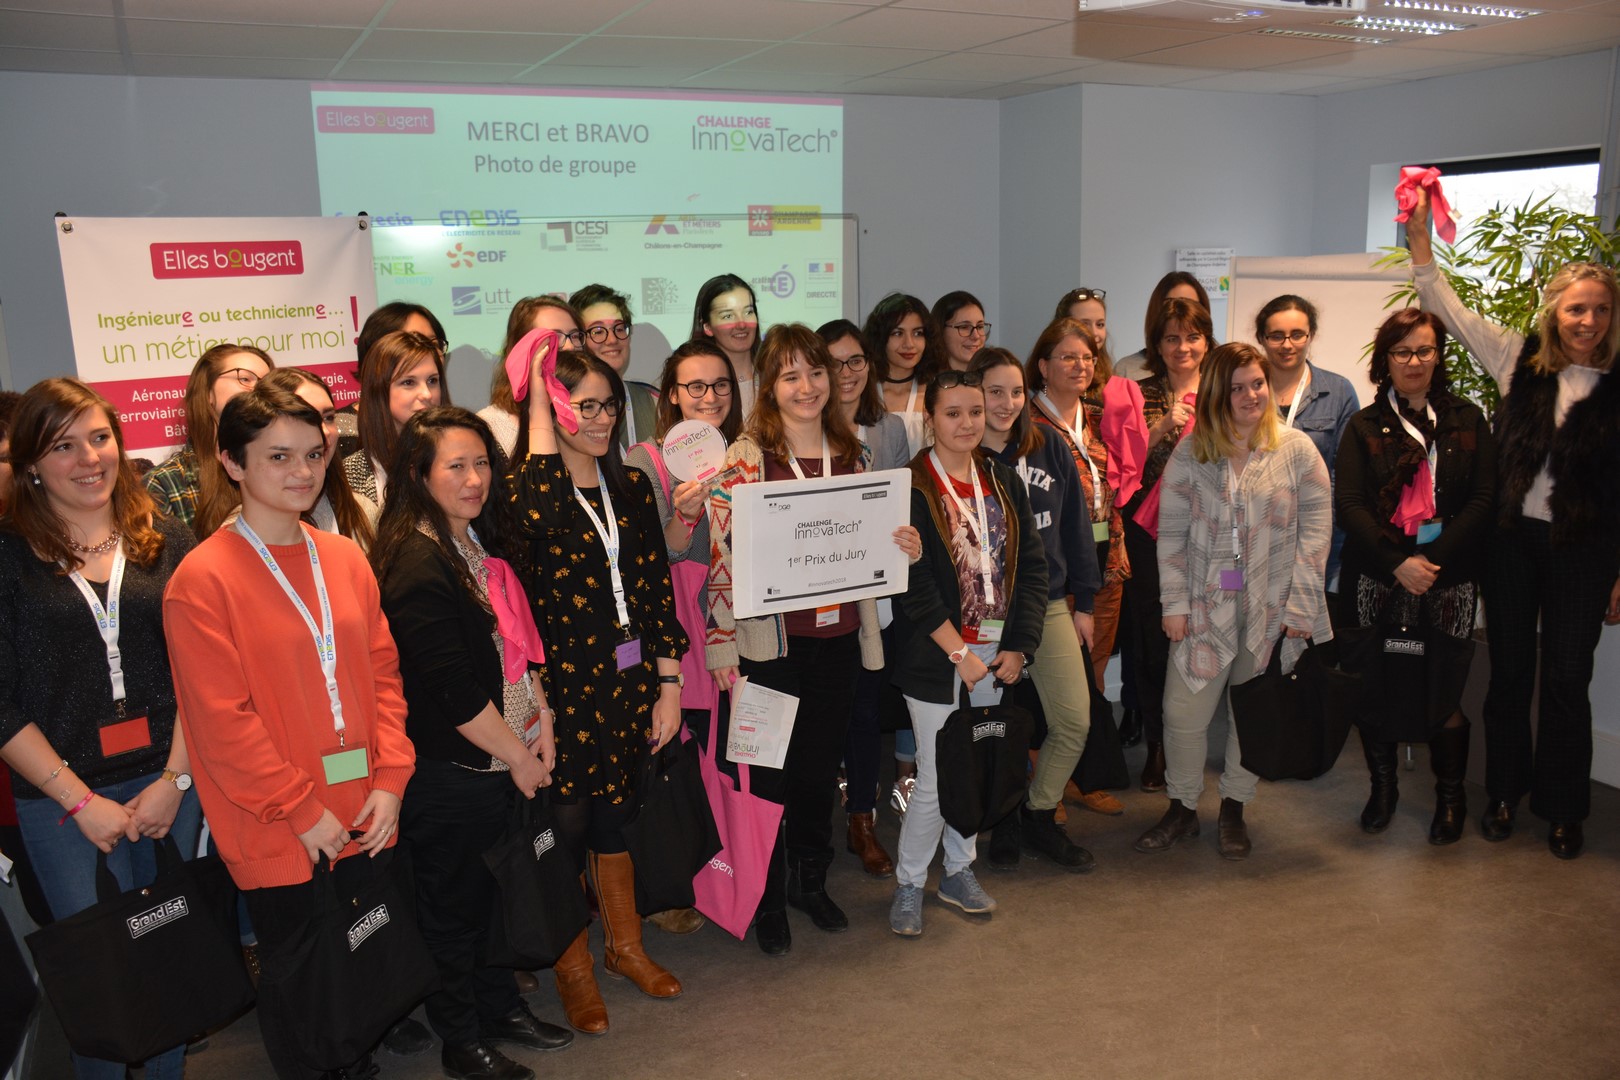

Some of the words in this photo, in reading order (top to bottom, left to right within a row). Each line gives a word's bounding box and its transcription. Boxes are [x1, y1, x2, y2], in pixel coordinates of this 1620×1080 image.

[326, 112, 360, 127] Elles
[364, 112, 429, 130] bougent
[696, 115, 772, 129] CHALLENGE
[467, 121, 539, 142] MERCI
[547, 124, 568, 142] et
[576, 123, 649, 143] BRAVO
[474, 155, 534, 174] Photo
[539, 156, 563, 174] de
[569, 158, 637, 177] groupe
[163, 250, 209, 270] Elles
[214, 249, 297, 271] bougent
[485, 288, 512, 304] utt
[98, 310, 194, 331] Ingénieure
[199, 311, 221, 323] ou
[103, 344, 136, 364] un
[302, 324, 345, 349] moi
[132, 388, 187, 402] Aéronau
[322, 373, 347, 387] rgie,
[797, 519, 832, 529] CHALLENGE
[804, 553, 827, 566] Prix
[829, 552, 842, 563] du
[845, 549, 867, 561] Jury
